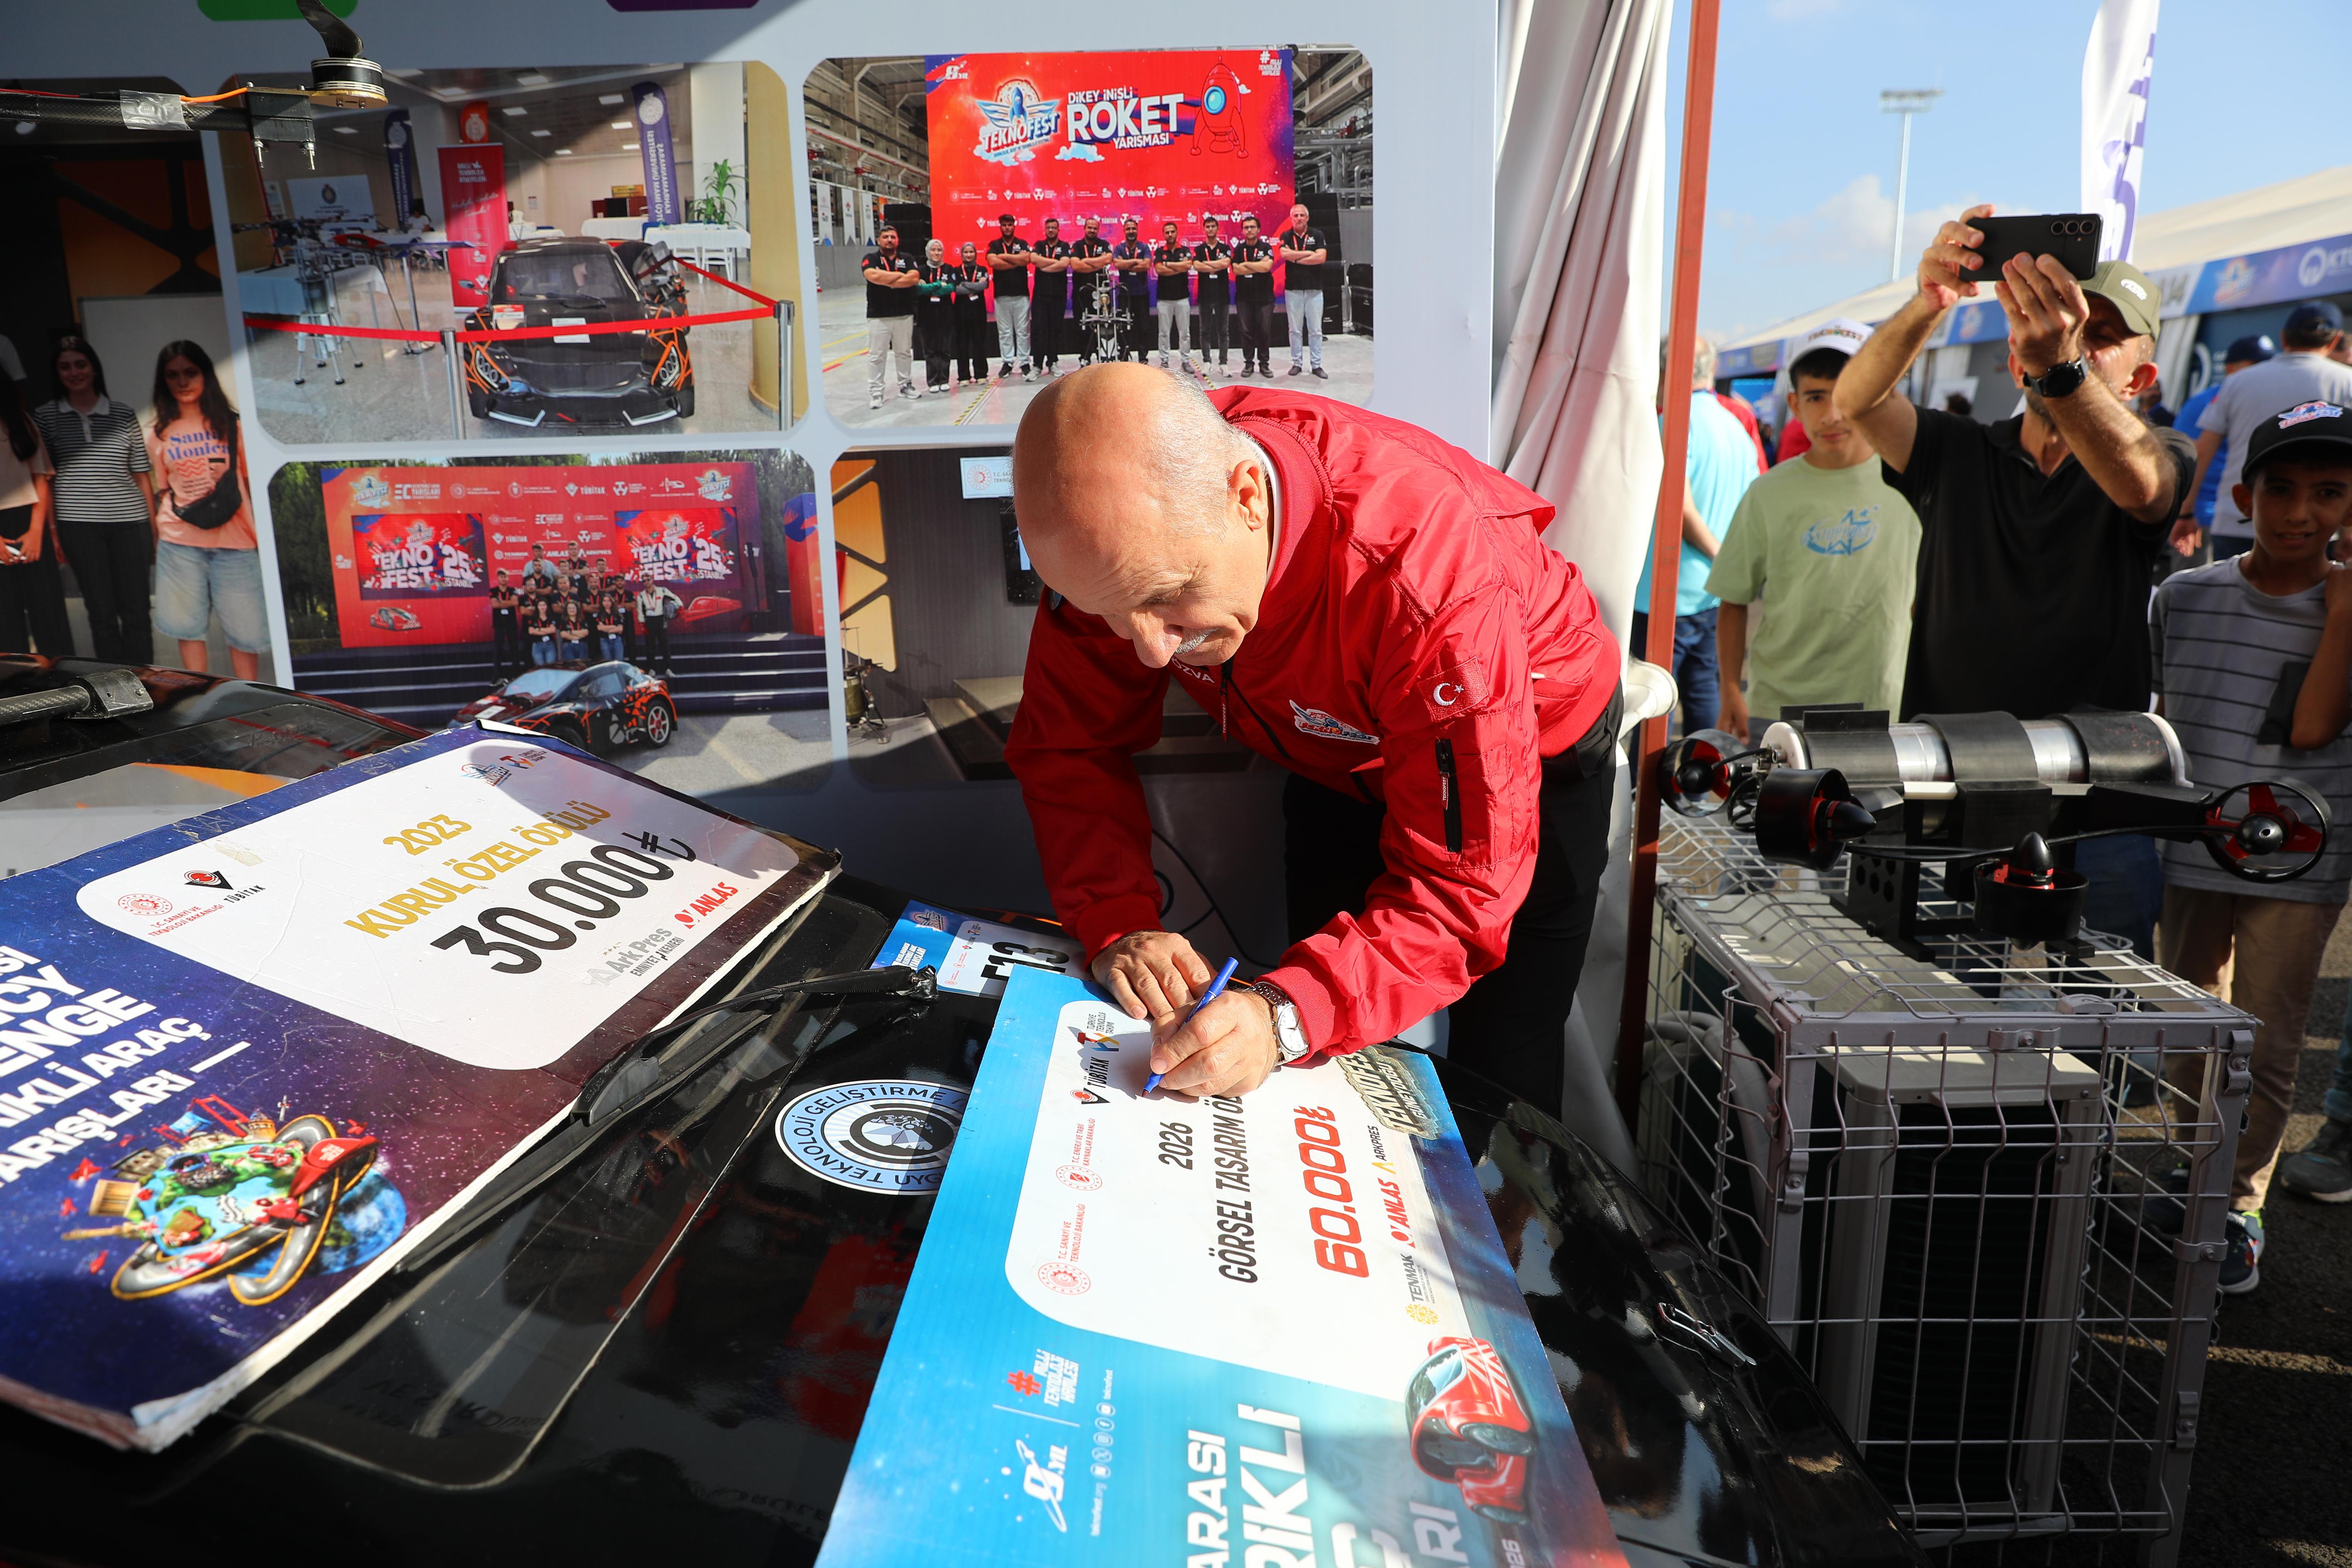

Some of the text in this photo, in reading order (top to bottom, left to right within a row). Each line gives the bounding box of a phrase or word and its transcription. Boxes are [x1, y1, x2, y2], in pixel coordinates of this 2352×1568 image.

[1067, 92, 1185, 142] ROKET
[1068, 91, 1100, 104] DİKEY
[984, 113, 1060, 152] TEKNOFEST
[372, 543, 434, 571] TEKNO
[631, 538, 688, 564] TEKNO
[643, 560, 688, 581] FEST
[385, 566, 434, 589] FEST
[1299, 720, 1374, 741] TEKNOFEST
[383, 814, 472, 856] 2023
[343, 800, 611, 939] KURUL ÖZEL ÖDÜLÜ
[223, 885, 266, 903] TÜBİTAK
[690, 881, 739, 917] ANLAS
[147, 904, 225, 937] TEKNOLOJİ BAKANLIĞI
[164, 909, 191, 923] SANAYİ
[605, 928, 673, 974] Ark Pres
[630, 936, 685, 977] EMNİYET KEMERİ
[0, 964, 85, 1025] CY
[1087, 1013, 1097, 1030] TÜRKİYE
[1097, 1012, 1106, 1032] TEKNOLOJİ
[1106, 1022, 1114, 1034] TAKIMI
[81, 1017, 211, 1078] ARAÇ
[1084, 1057, 1109, 1088] TÜBİTAK
[1339, 1049, 1420, 1132] TEKNOFES
[1376, 1061, 1426, 1119] GÜNEYDOĞU
[792, 1085, 946, 1183] TEKNOLOJİ GELİŞTİRME
[1073, 1139, 1082, 1155] ENERJİ
[1082, 1118, 1096, 1167] KAYNAKLAR BAKANLIĞI
[1158, 1121, 1193, 1170] 2026
[1213, 1114, 1251, 1193] TASARIM
[1368, 1125, 1388, 1161] ARKPRES
[1294, 1105, 1369, 1278] 60.000₺
[1378, 1177, 1413, 1229] ANLAS
[1060, 1228, 1071, 1250] SANAYİ
[1070, 1203, 1086, 1262] TEKNOLOJİ BAKANLIĞI
[1208, 1199, 1258, 1284] GÖRSEL
[1400, 1253, 1425, 1302] TENMAK
[1103, 1369, 1114, 1400] teknofest
